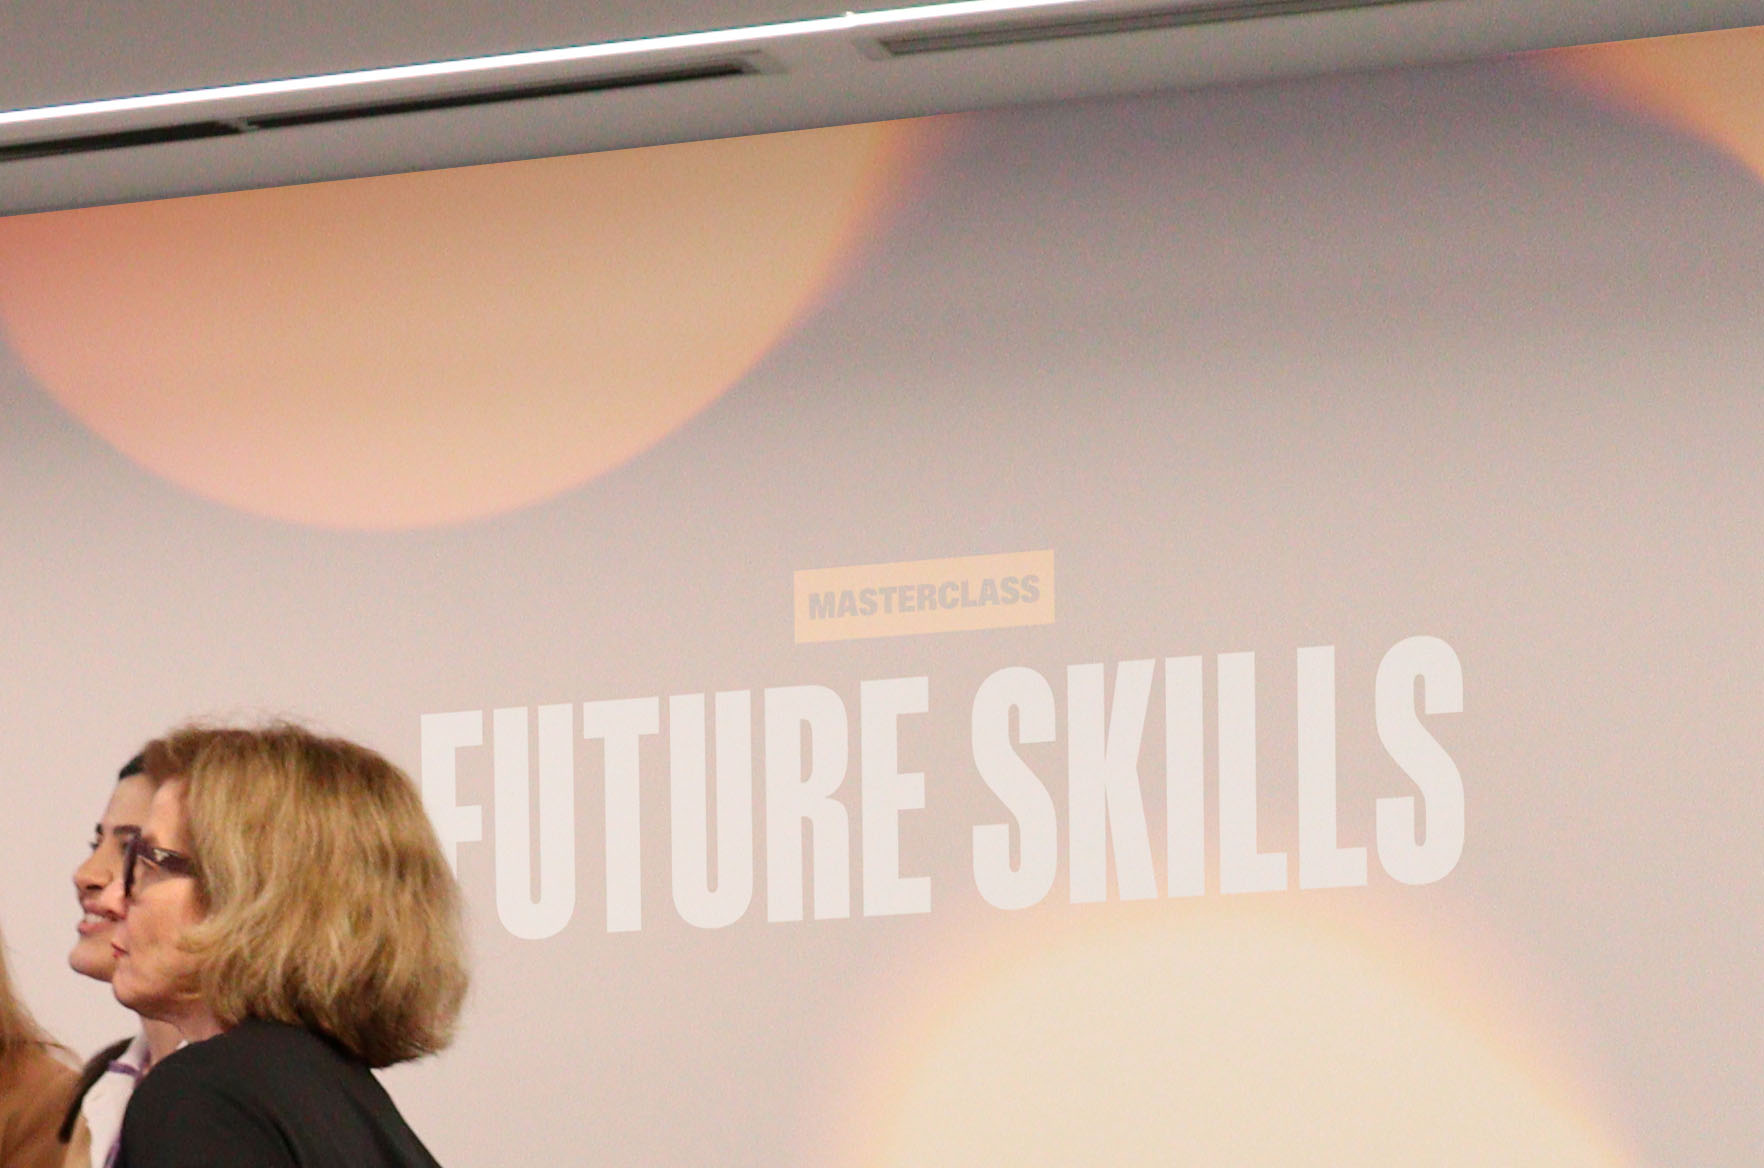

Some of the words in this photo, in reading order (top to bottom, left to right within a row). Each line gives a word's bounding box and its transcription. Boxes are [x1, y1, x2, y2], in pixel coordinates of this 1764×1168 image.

[807, 574, 1041, 621] MASTERCLASS
[420, 675, 932, 940] FUTURE
[970, 634, 1467, 912] SKILLS
